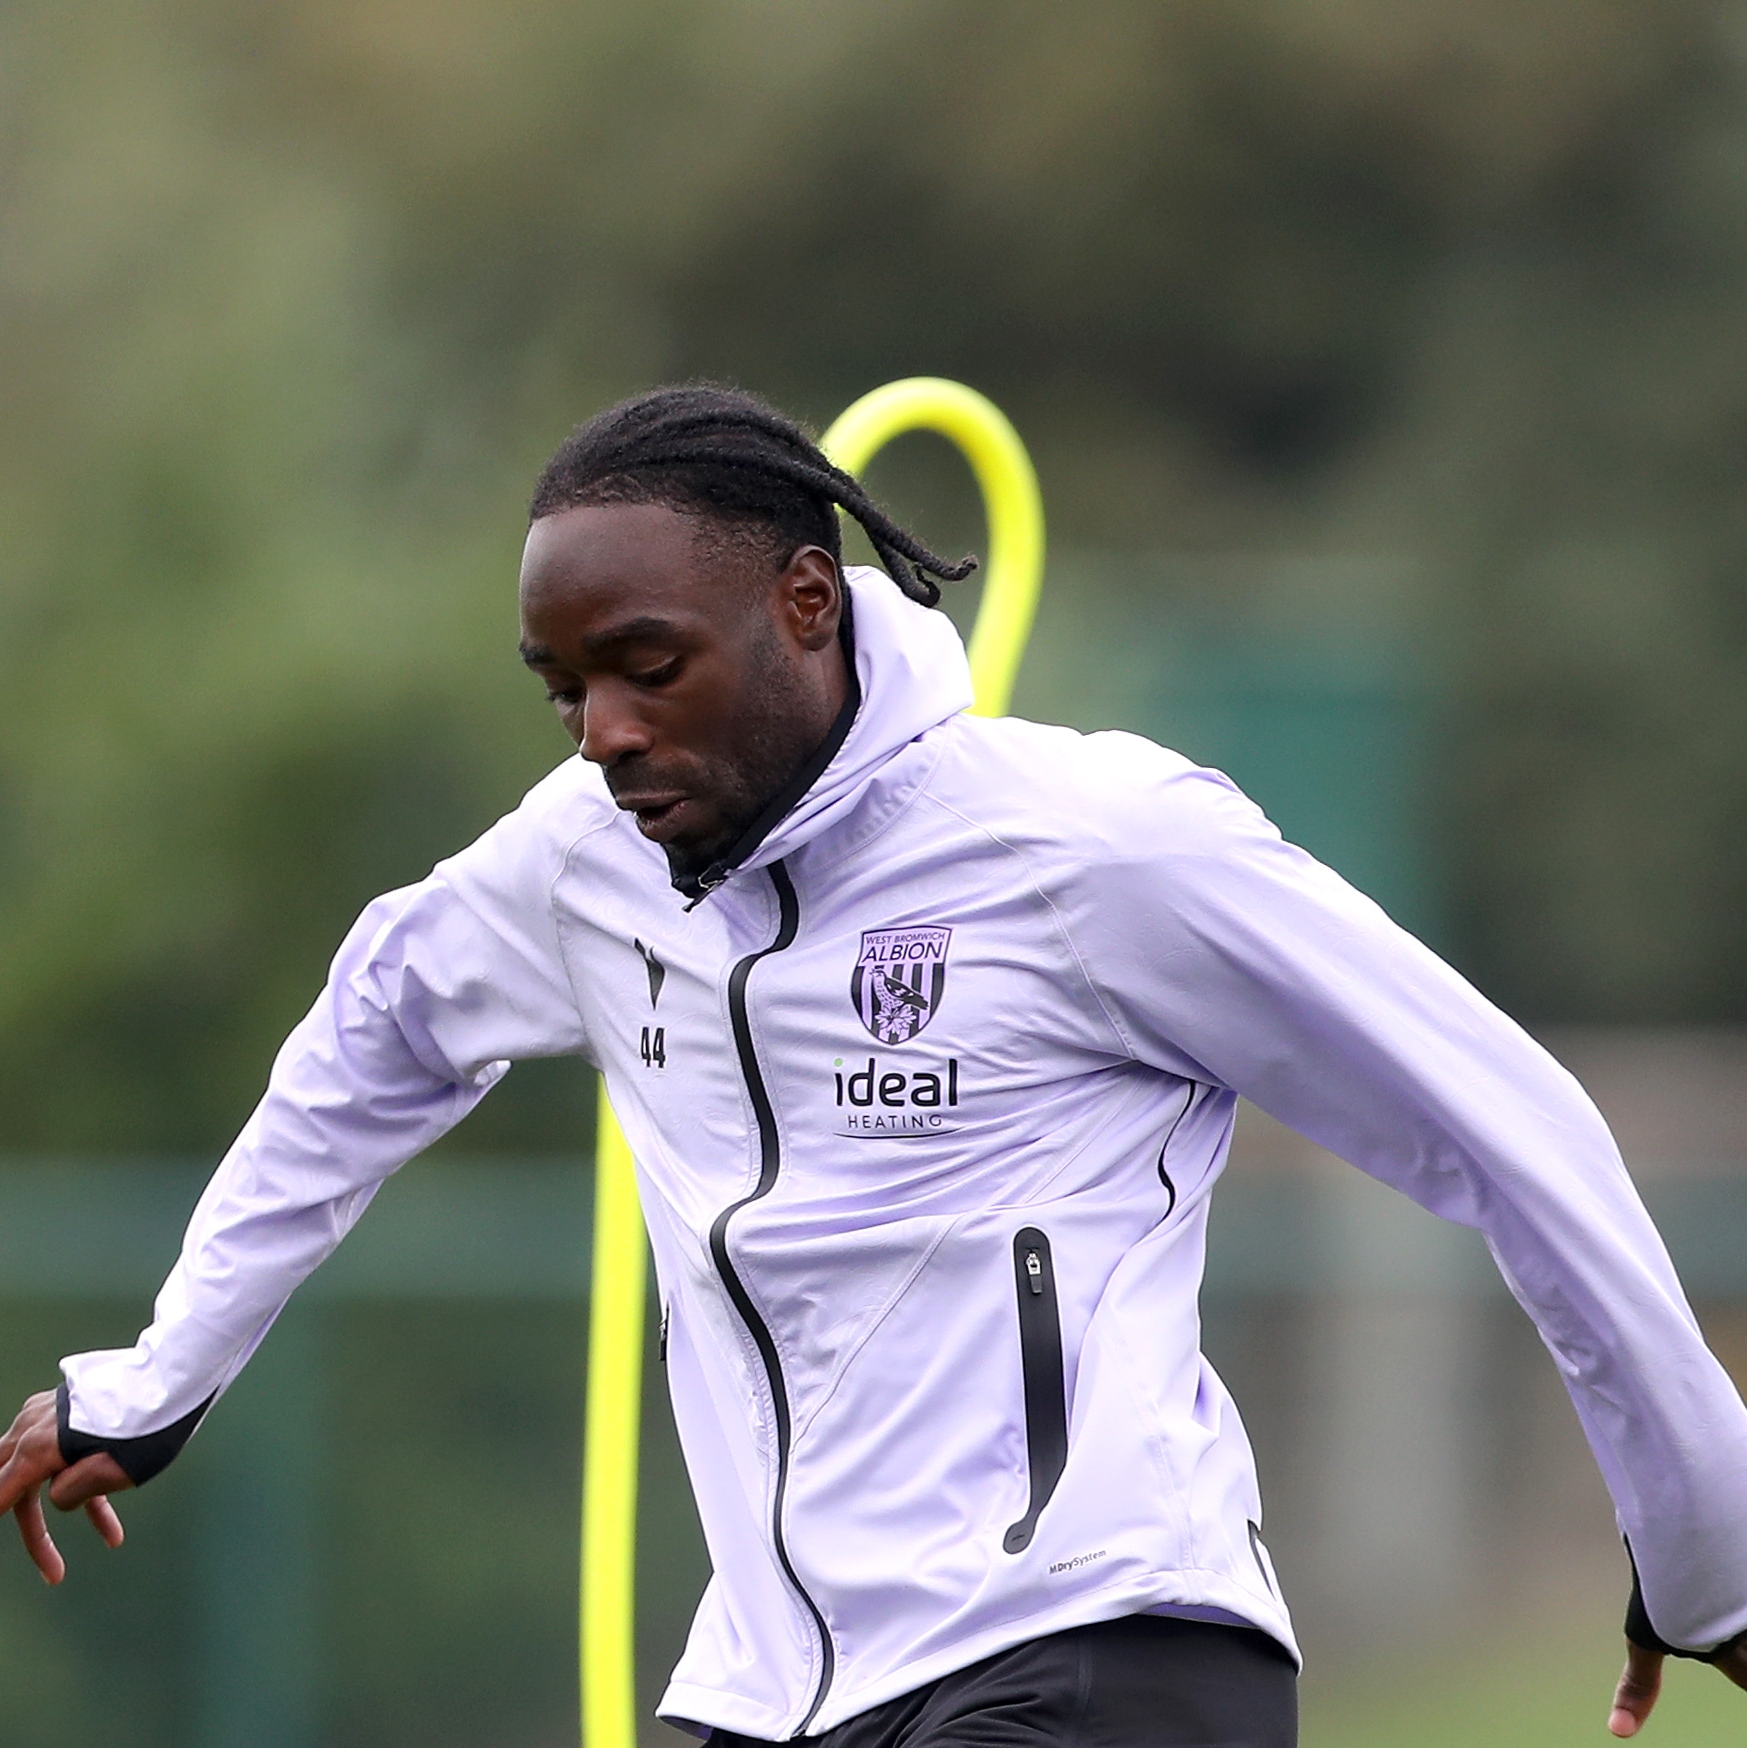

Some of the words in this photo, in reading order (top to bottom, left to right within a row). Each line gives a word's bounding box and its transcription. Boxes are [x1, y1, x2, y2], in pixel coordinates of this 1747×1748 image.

[865, 935, 892, 945] WEST
[894, 932, 946, 944] BROMWICH
[861, 941, 943, 963] ALBION
[640, 1026, 666, 1069] 44
[834, 1057, 958, 1107] ideal
[847, 1114, 943, 1129] HEATING
